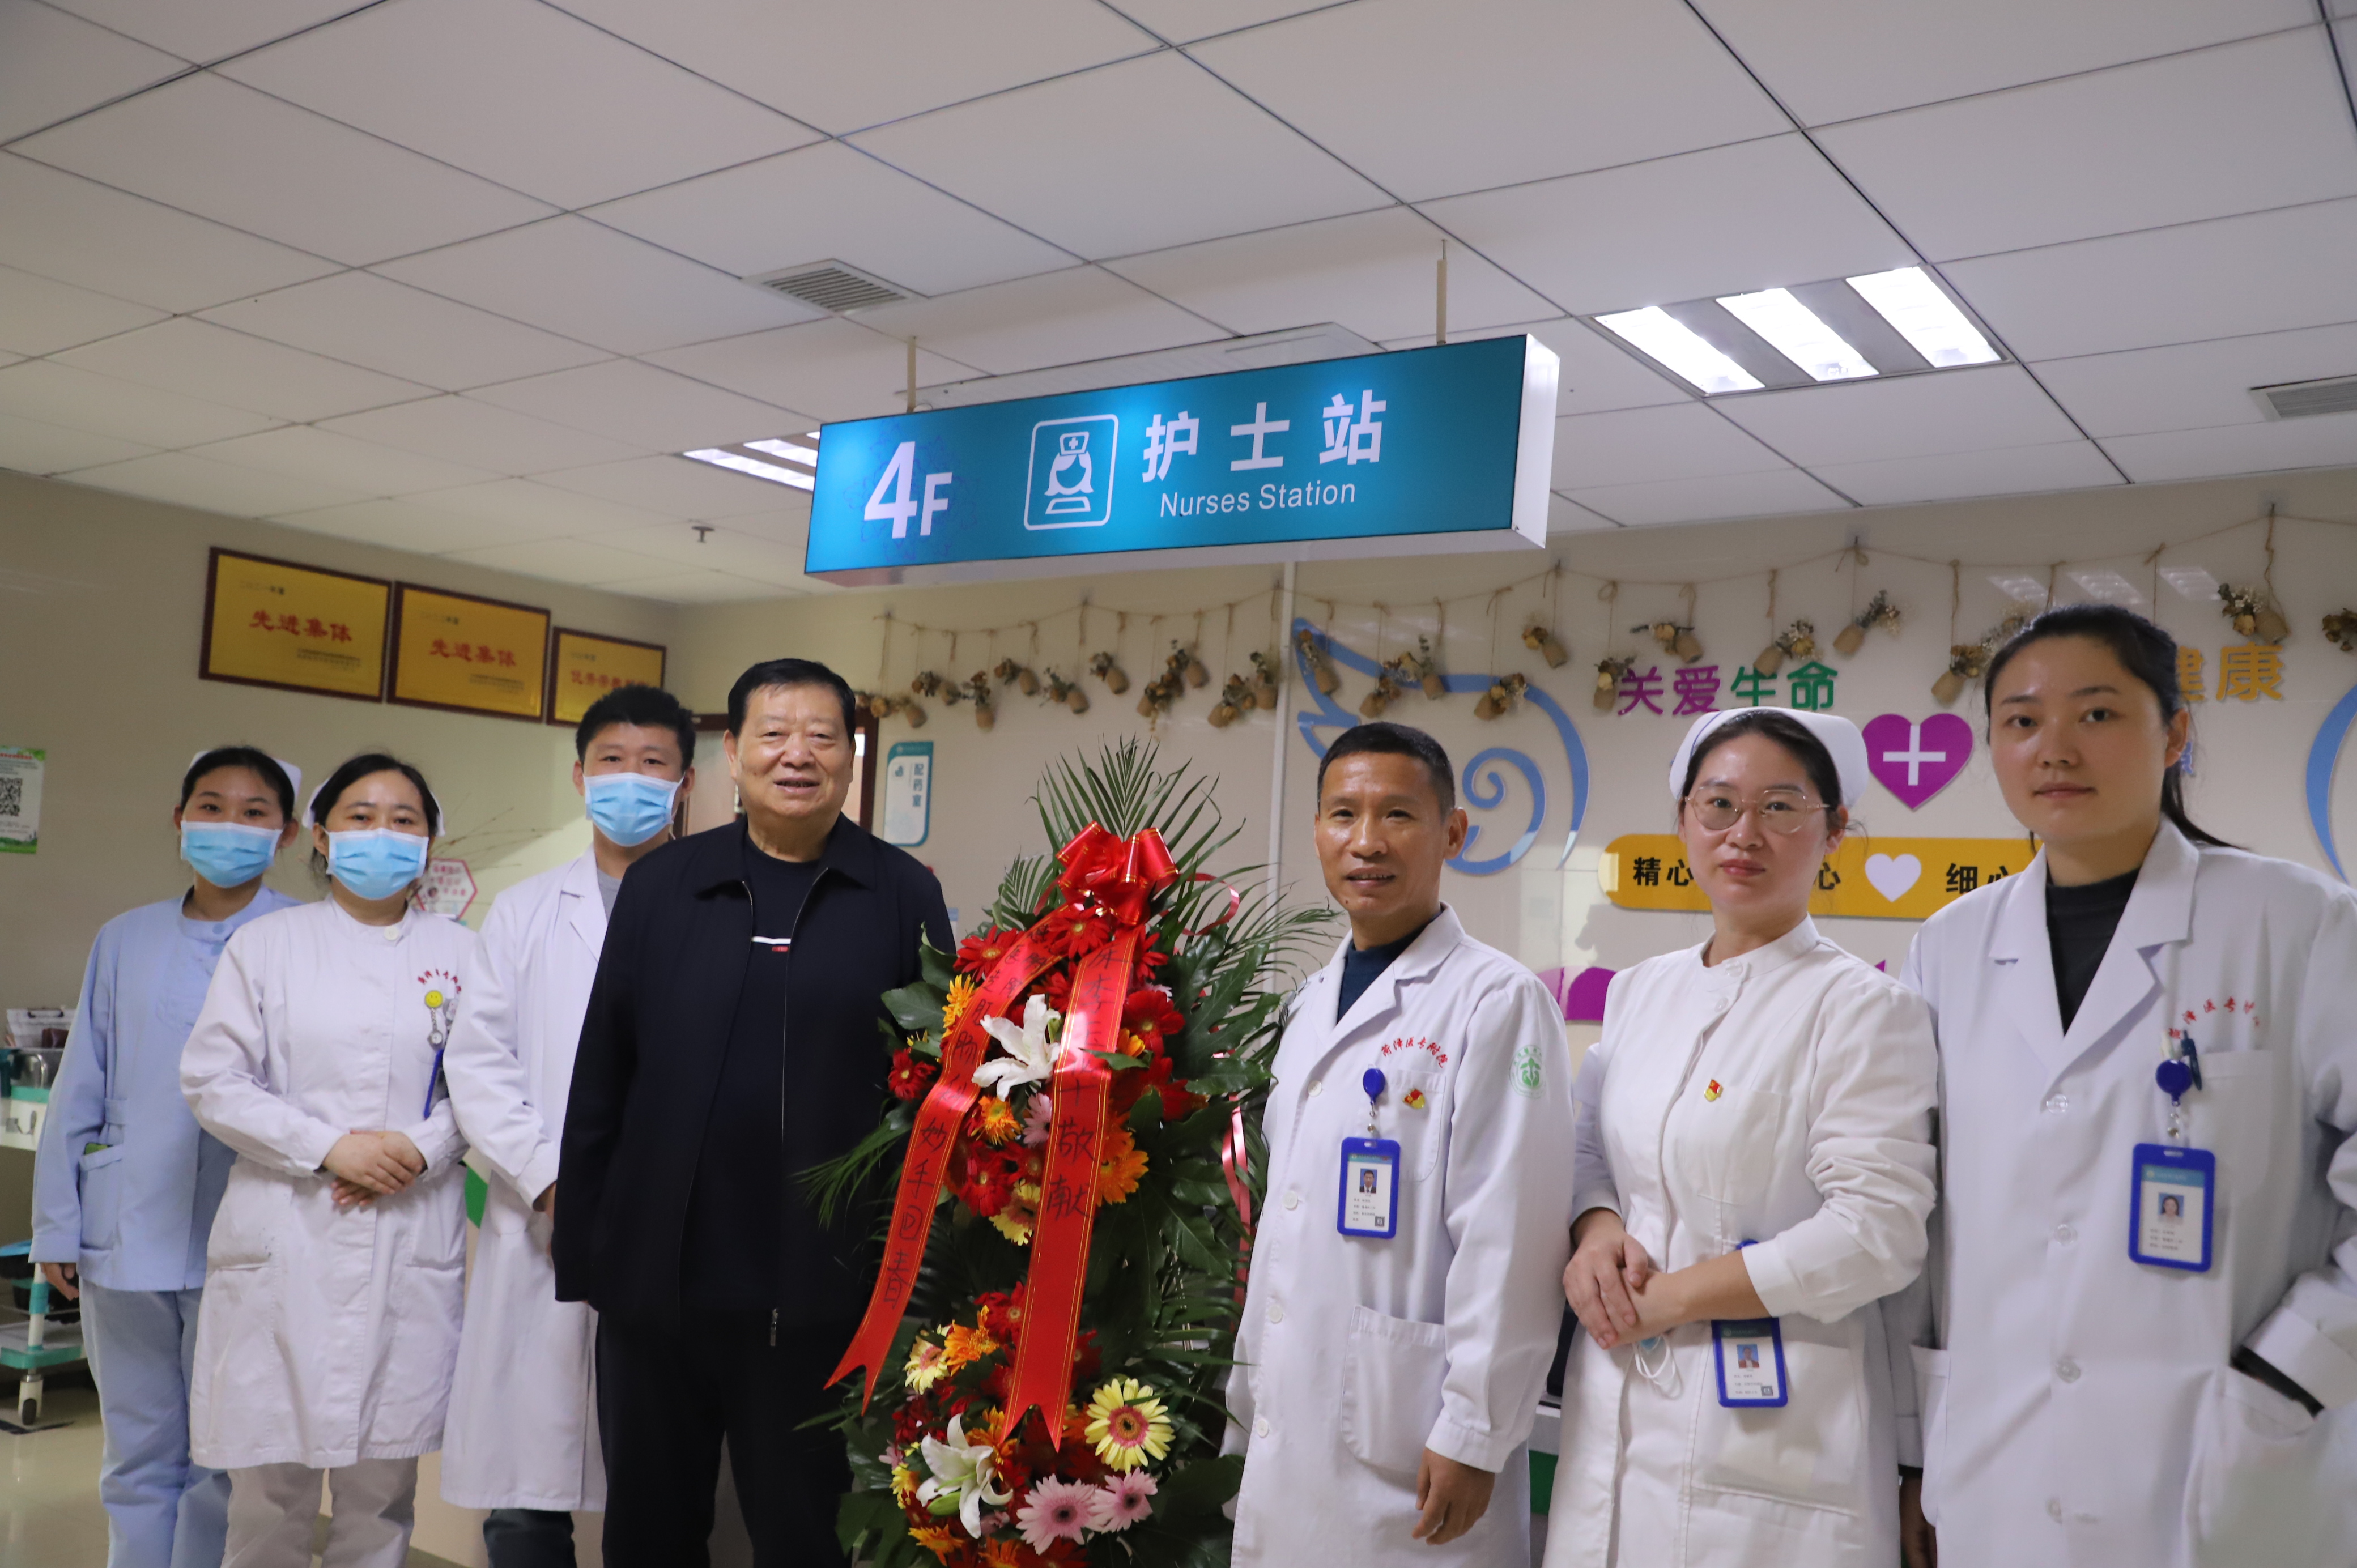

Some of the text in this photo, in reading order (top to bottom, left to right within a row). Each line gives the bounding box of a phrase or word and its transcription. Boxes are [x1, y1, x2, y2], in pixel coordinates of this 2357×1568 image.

[1142, 389, 1387, 483] 护士站
[863, 441, 952, 539] 4F
[1160, 482, 1355, 517] Nurses Station
[249, 609, 352, 643] 先进集体
[429, 638, 517, 668] 先进集体
[1618, 661, 1838, 715] 关爱生命
[1633, 856, 1694, 886] 精心
